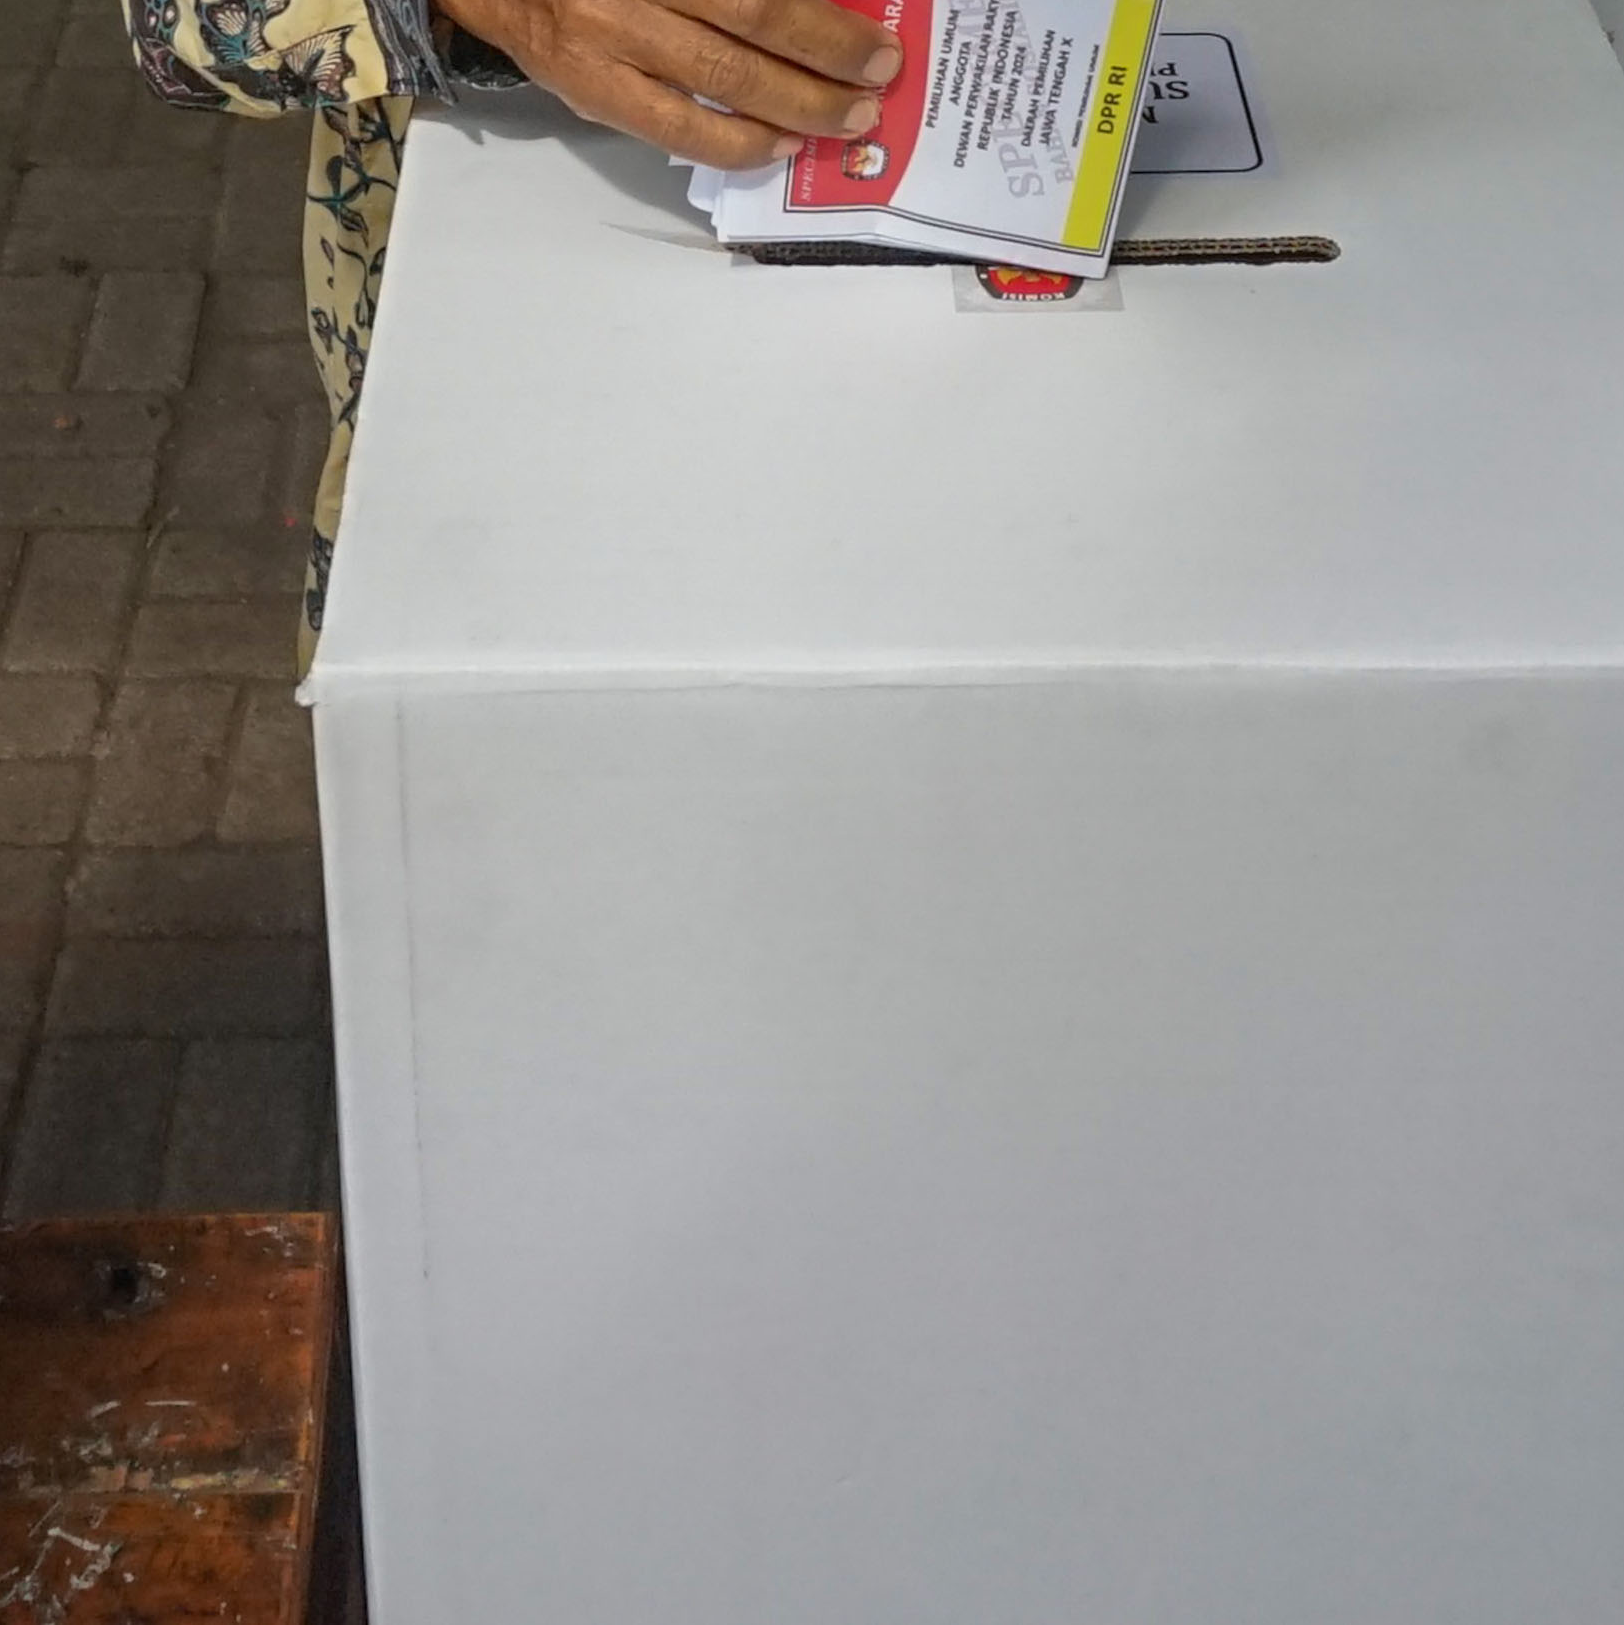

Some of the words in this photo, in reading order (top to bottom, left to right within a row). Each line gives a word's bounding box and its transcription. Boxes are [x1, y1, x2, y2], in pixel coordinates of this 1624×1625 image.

[925, 57, 950, 129] PEMILIHAN
[941, 8, 961, 54] UMUM
[948, 40, 972, 106] ANGGOTA
[953, 120, 974, 168] DEWAN
[964, 33, 992, 119] PERWAKILAN
[977, 87, 1001, 151] REPUBLIK
[992, 9, 1019, 84] INDONESIA
[1001, 77, 1021, 122] TAHUN
[1011, 45, 1027, 76] 2024
[1020, 98, 1040, 147] DAERAH
[1033, 29, 1056, 96] PEMILIHAN
[1039, 109, 1057, 146] JAWA
[1048, 50, 1071, 105] TENGAH
[1061, 36, 1074, 48] X
[1097, 92, 1122, 135] DPR
[1108, 65, 1128, 86] RI
